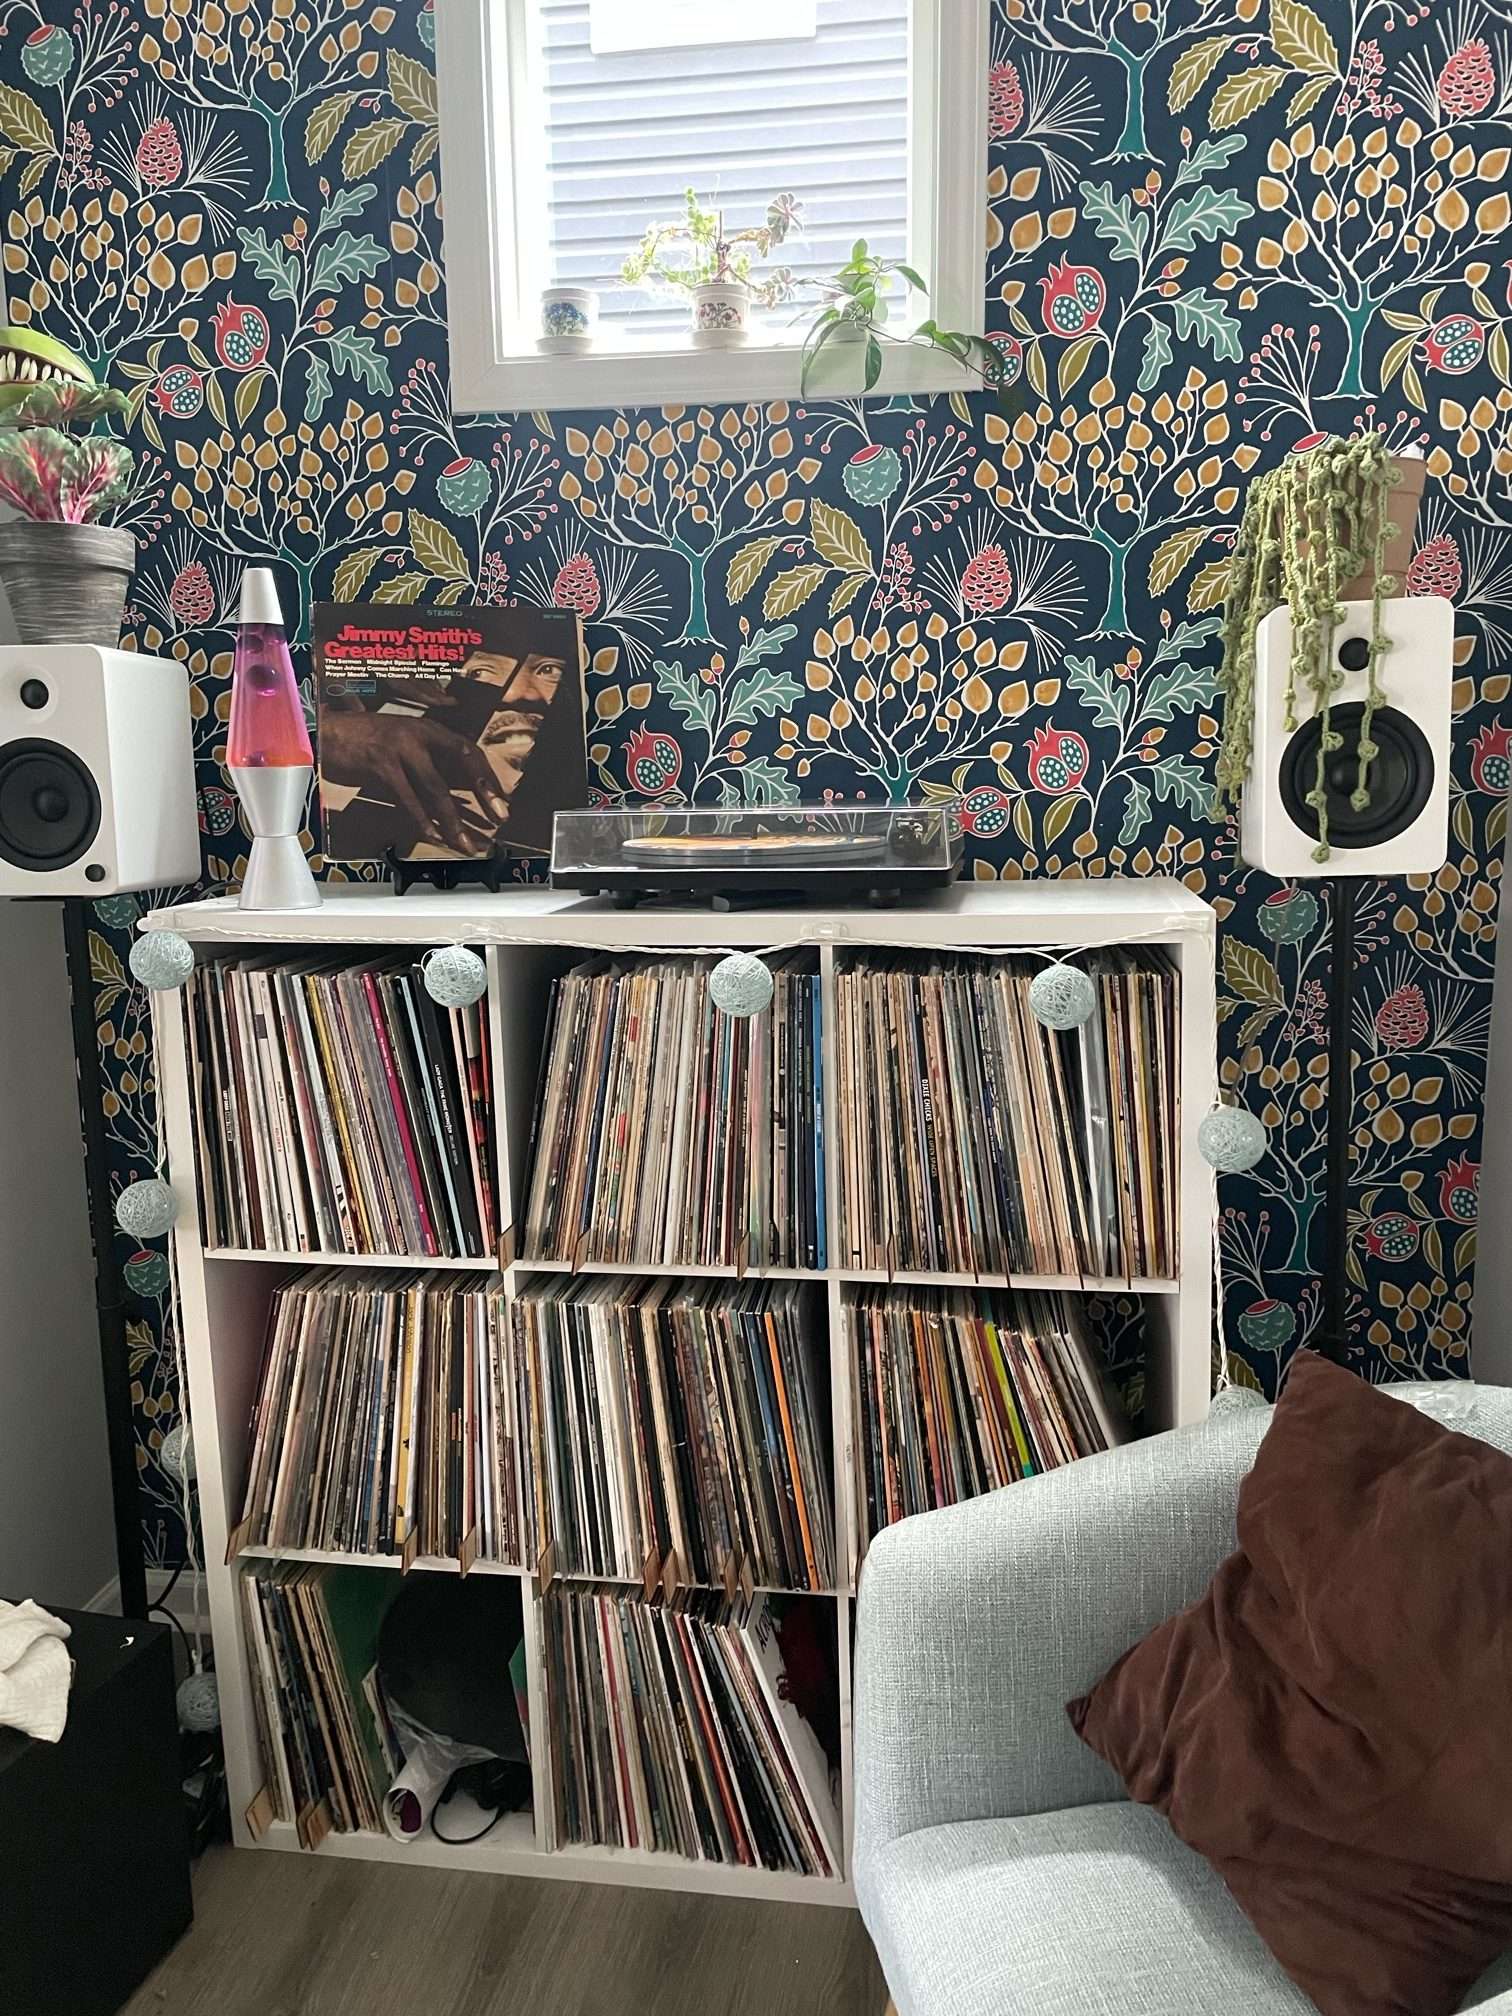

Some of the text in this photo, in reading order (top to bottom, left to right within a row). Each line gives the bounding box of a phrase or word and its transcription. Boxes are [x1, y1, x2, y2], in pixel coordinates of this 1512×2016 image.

[427, 609, 463, 617] STEREO
[337, 624, 482, 645] Jimmy Smith's
[324, 641, 465, 661] Greatest Hits!
[921, 1079, 930, 1098] DIXIE
[923, 1099, 932, 1121] CHICKS
